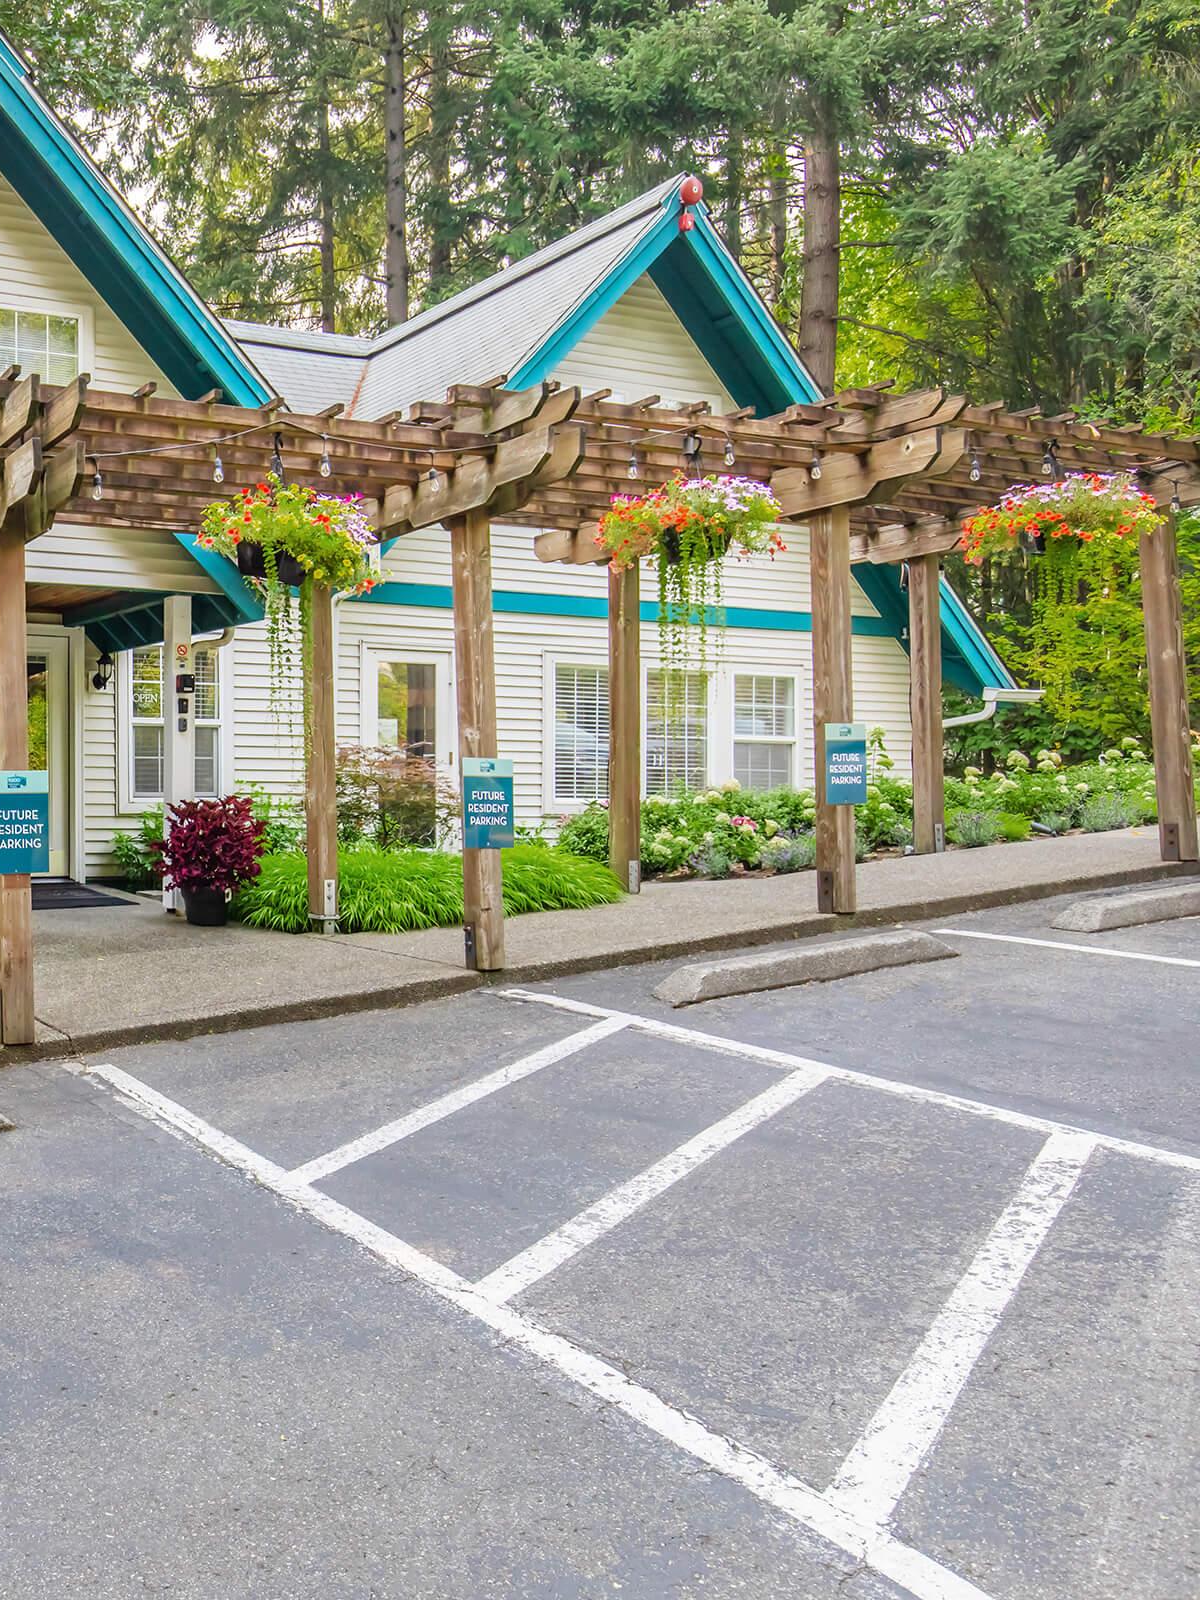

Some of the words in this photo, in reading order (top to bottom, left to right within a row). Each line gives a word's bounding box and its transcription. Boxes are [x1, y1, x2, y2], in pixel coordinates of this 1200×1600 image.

[133, 693, 158, 703] OPEN
[832, 753, 860, 762] FUTURE
[829, 764, 864, 773] RESIDENT
[831, 776, 862, 785] PARKING
[471, 791, 505, 801] FUTURE
[468, 803, 509, 813] RESIDENT
[470, 816, 507, 826] PARKING
